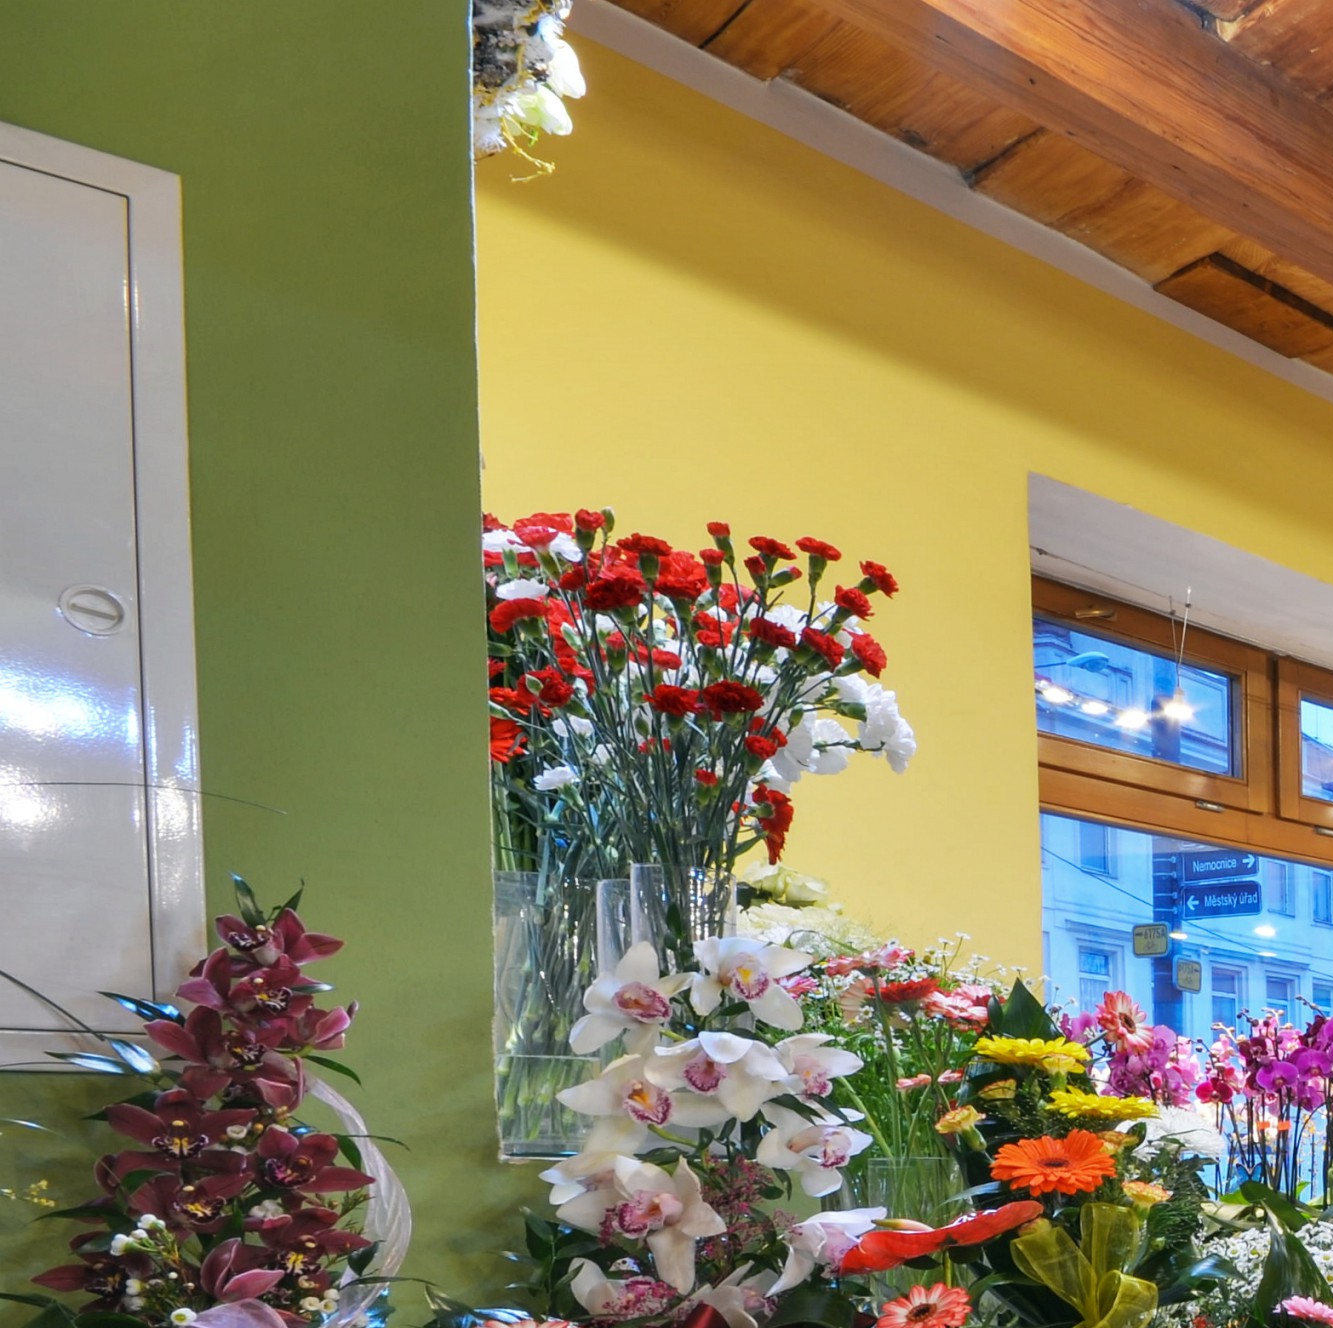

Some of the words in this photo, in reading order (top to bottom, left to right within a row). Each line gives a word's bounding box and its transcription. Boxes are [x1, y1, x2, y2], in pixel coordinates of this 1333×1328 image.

[1193, 858, 1237, 872] Nemocnice
[1204, 893, 1238, 908] Městský
[1239, 891, 1258, 904] úřad
